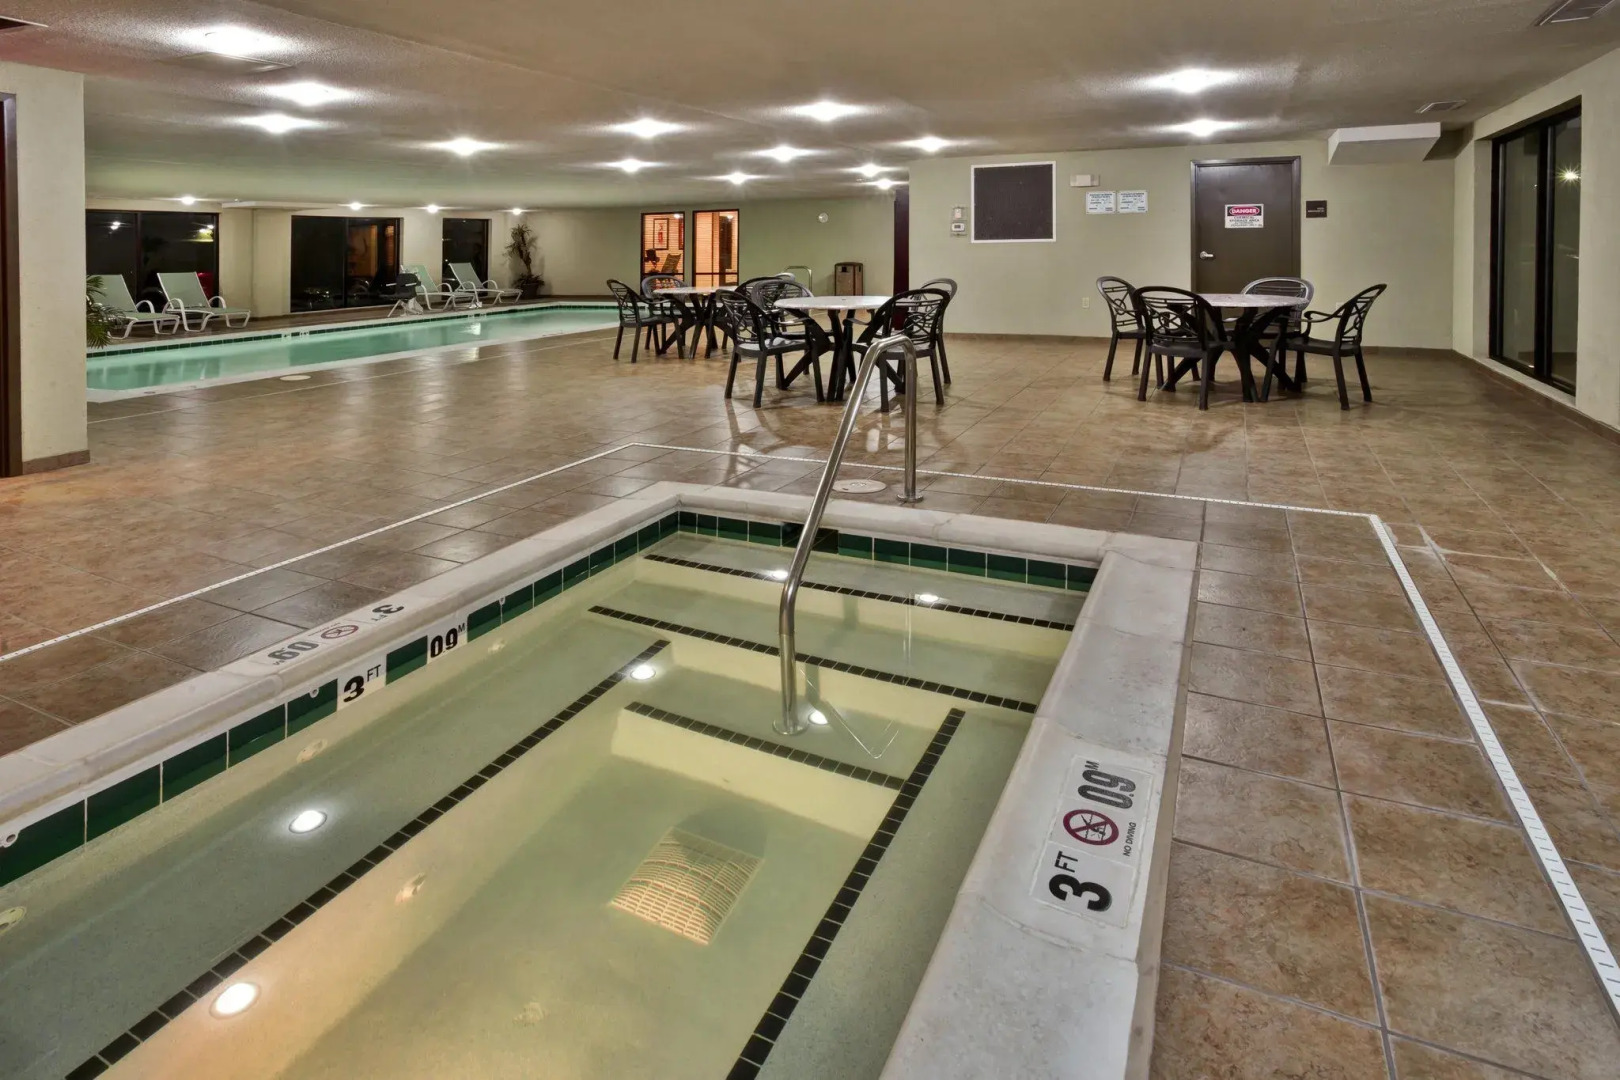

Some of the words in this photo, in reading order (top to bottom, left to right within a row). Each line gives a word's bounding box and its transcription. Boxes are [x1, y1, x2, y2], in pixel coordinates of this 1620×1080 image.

[372, 604, 405, 614] 3
[343, 675, 365, 703] 3
[366, 664, 381, 682] FT
[1126, 822, 1137, 843] DIVING
[1054, 850, 1078, 873] FT
[1123, 844, 1132, 857] NO
[1048, 873, 1112, 912] 3
